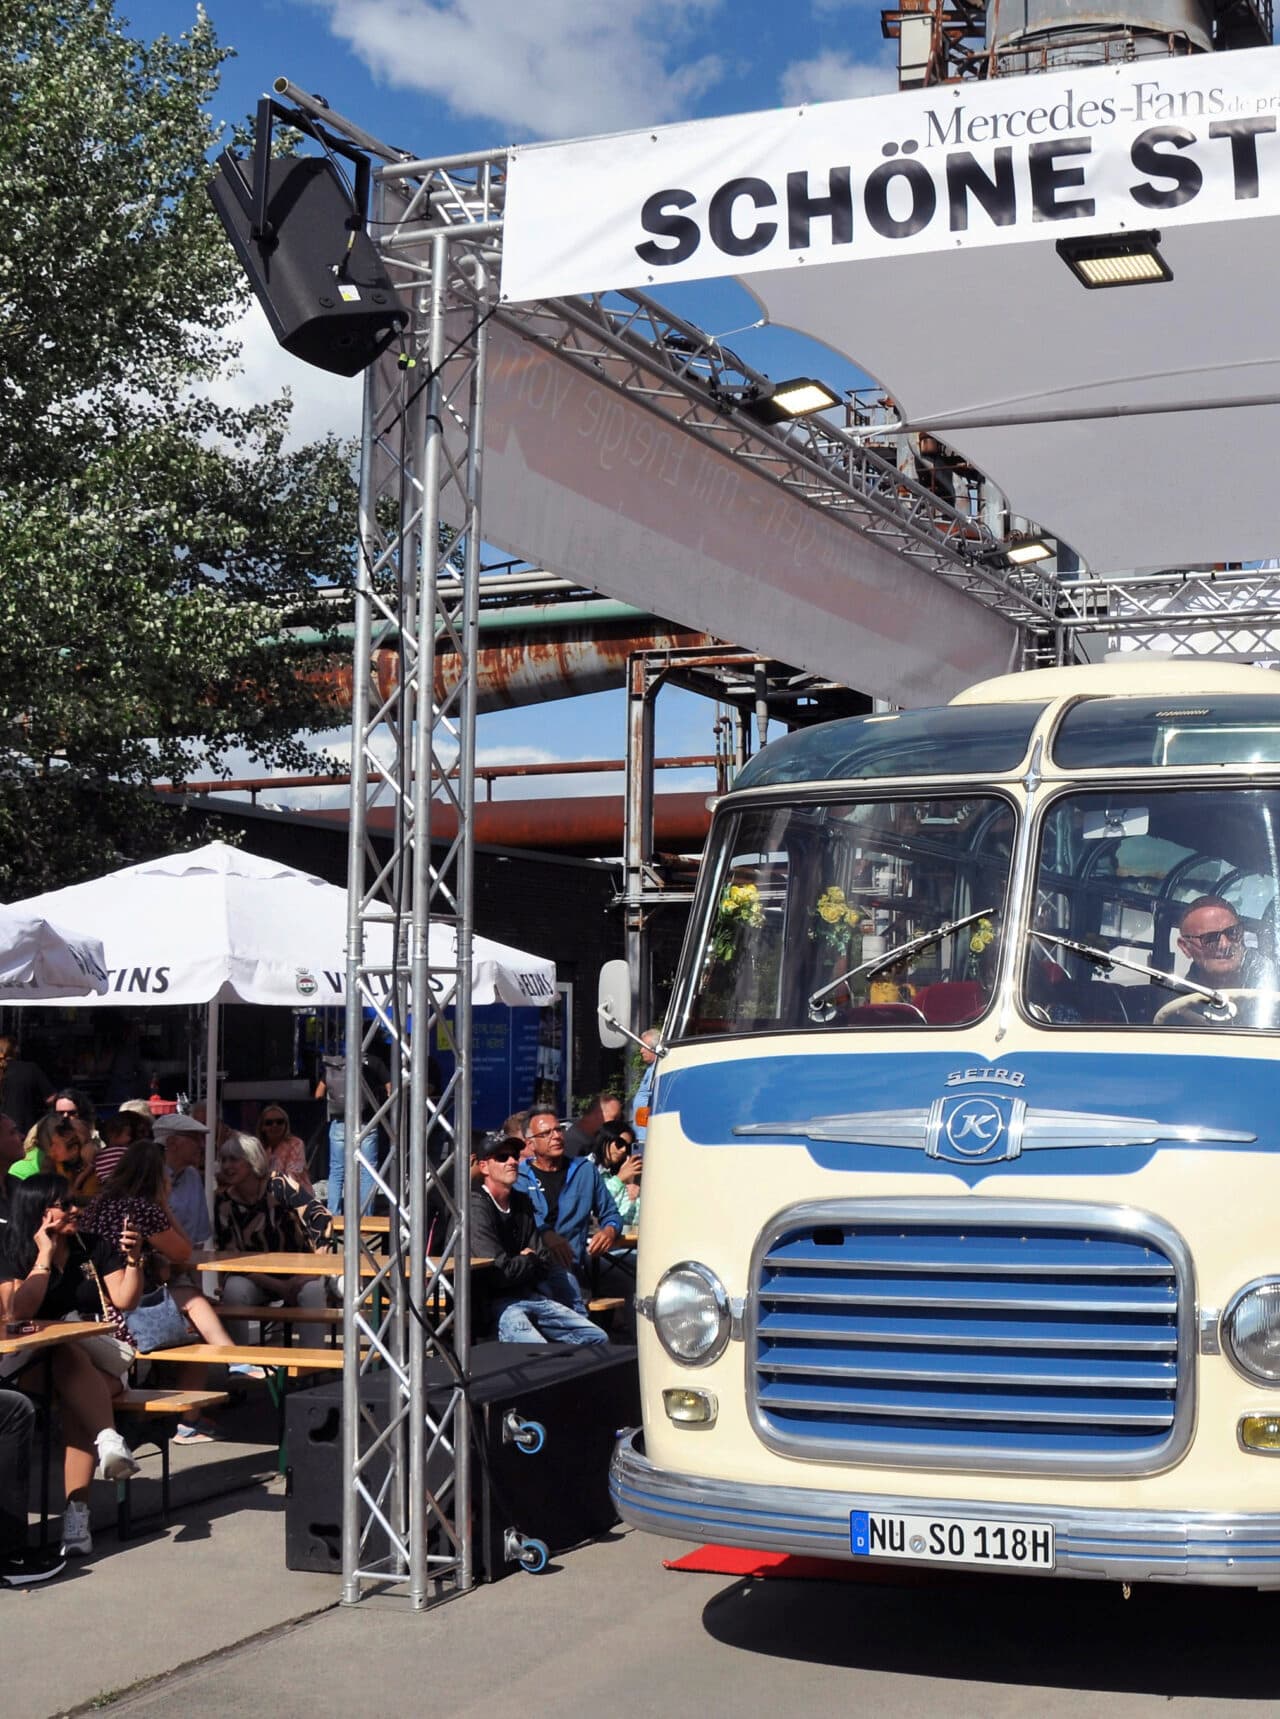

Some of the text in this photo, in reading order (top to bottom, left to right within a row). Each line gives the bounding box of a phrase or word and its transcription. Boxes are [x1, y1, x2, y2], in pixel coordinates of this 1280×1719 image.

[634, 136, 1097, 267] SCHÖNE
[946, 1067, 1025, 1086] SETRA
[953, 1114, 997, 1139] K
[857, 1537, 865, 1547] D
[870, 1518, 1050, 1563] NU SO 118H
